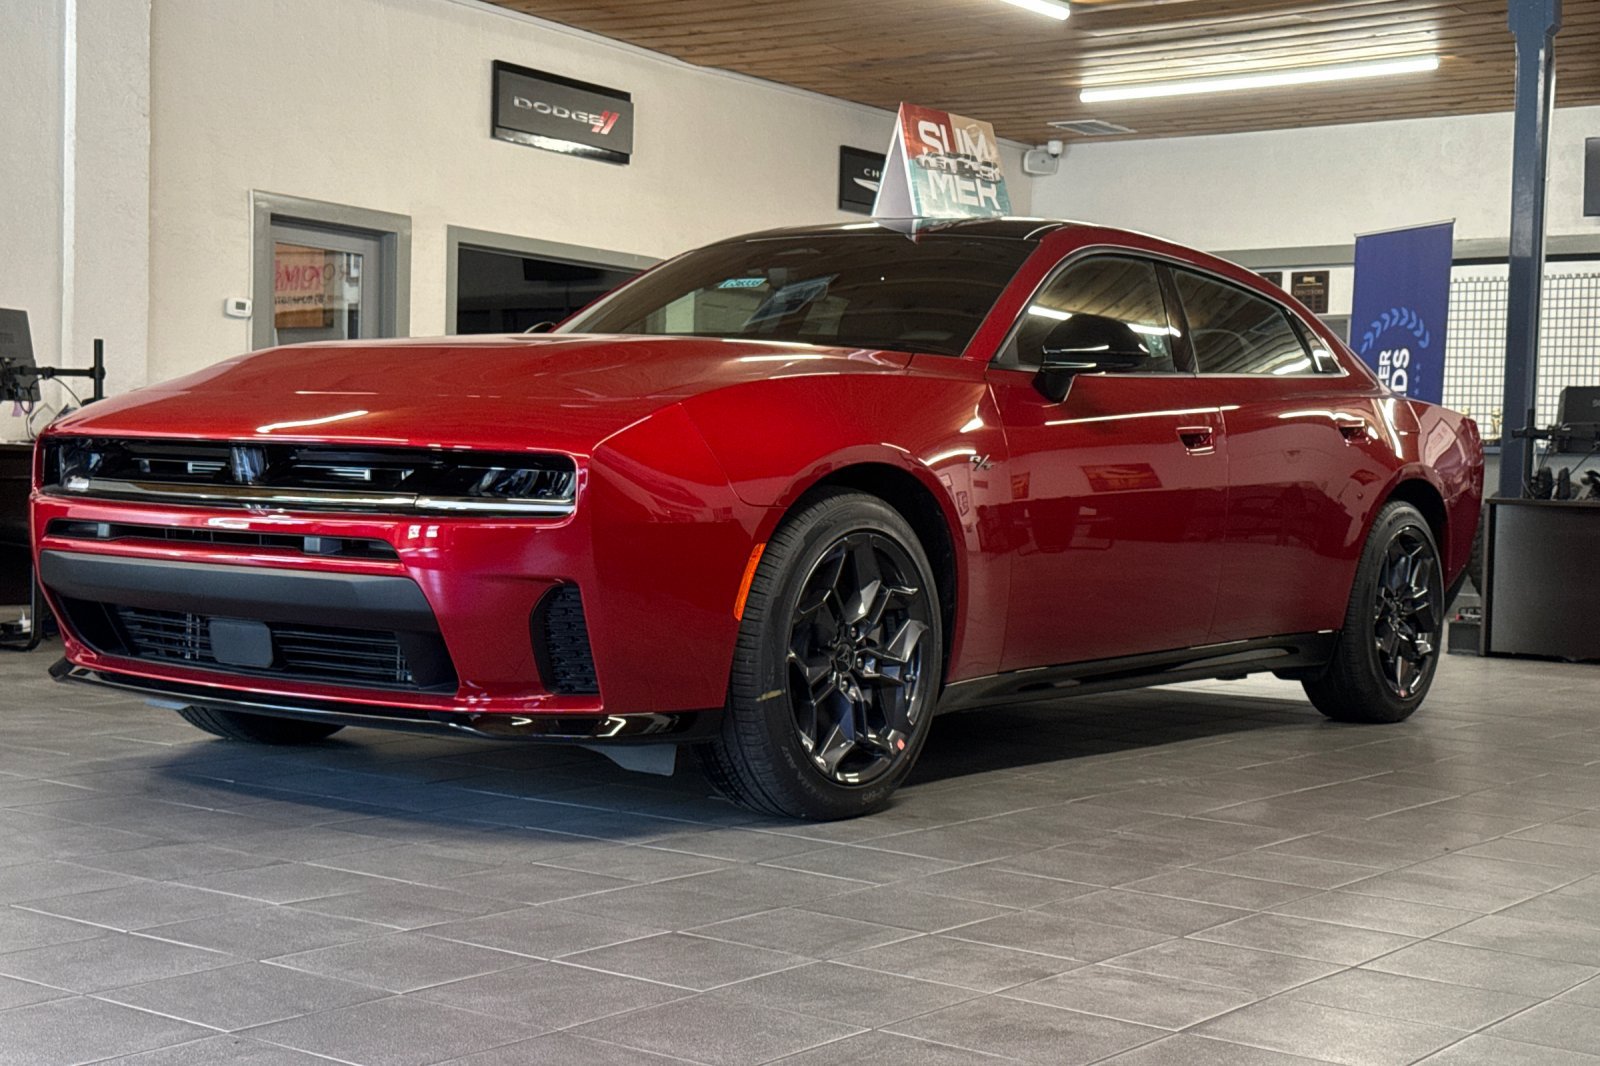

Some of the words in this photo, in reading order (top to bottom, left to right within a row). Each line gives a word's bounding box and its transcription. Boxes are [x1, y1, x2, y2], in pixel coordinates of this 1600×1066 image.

[513, 95, 605, 127] DODGE
[927, 168, 1002, 210] MER
[1378, 349, 1392, 387] ER
[1390, 348, 1410, 397] DS
